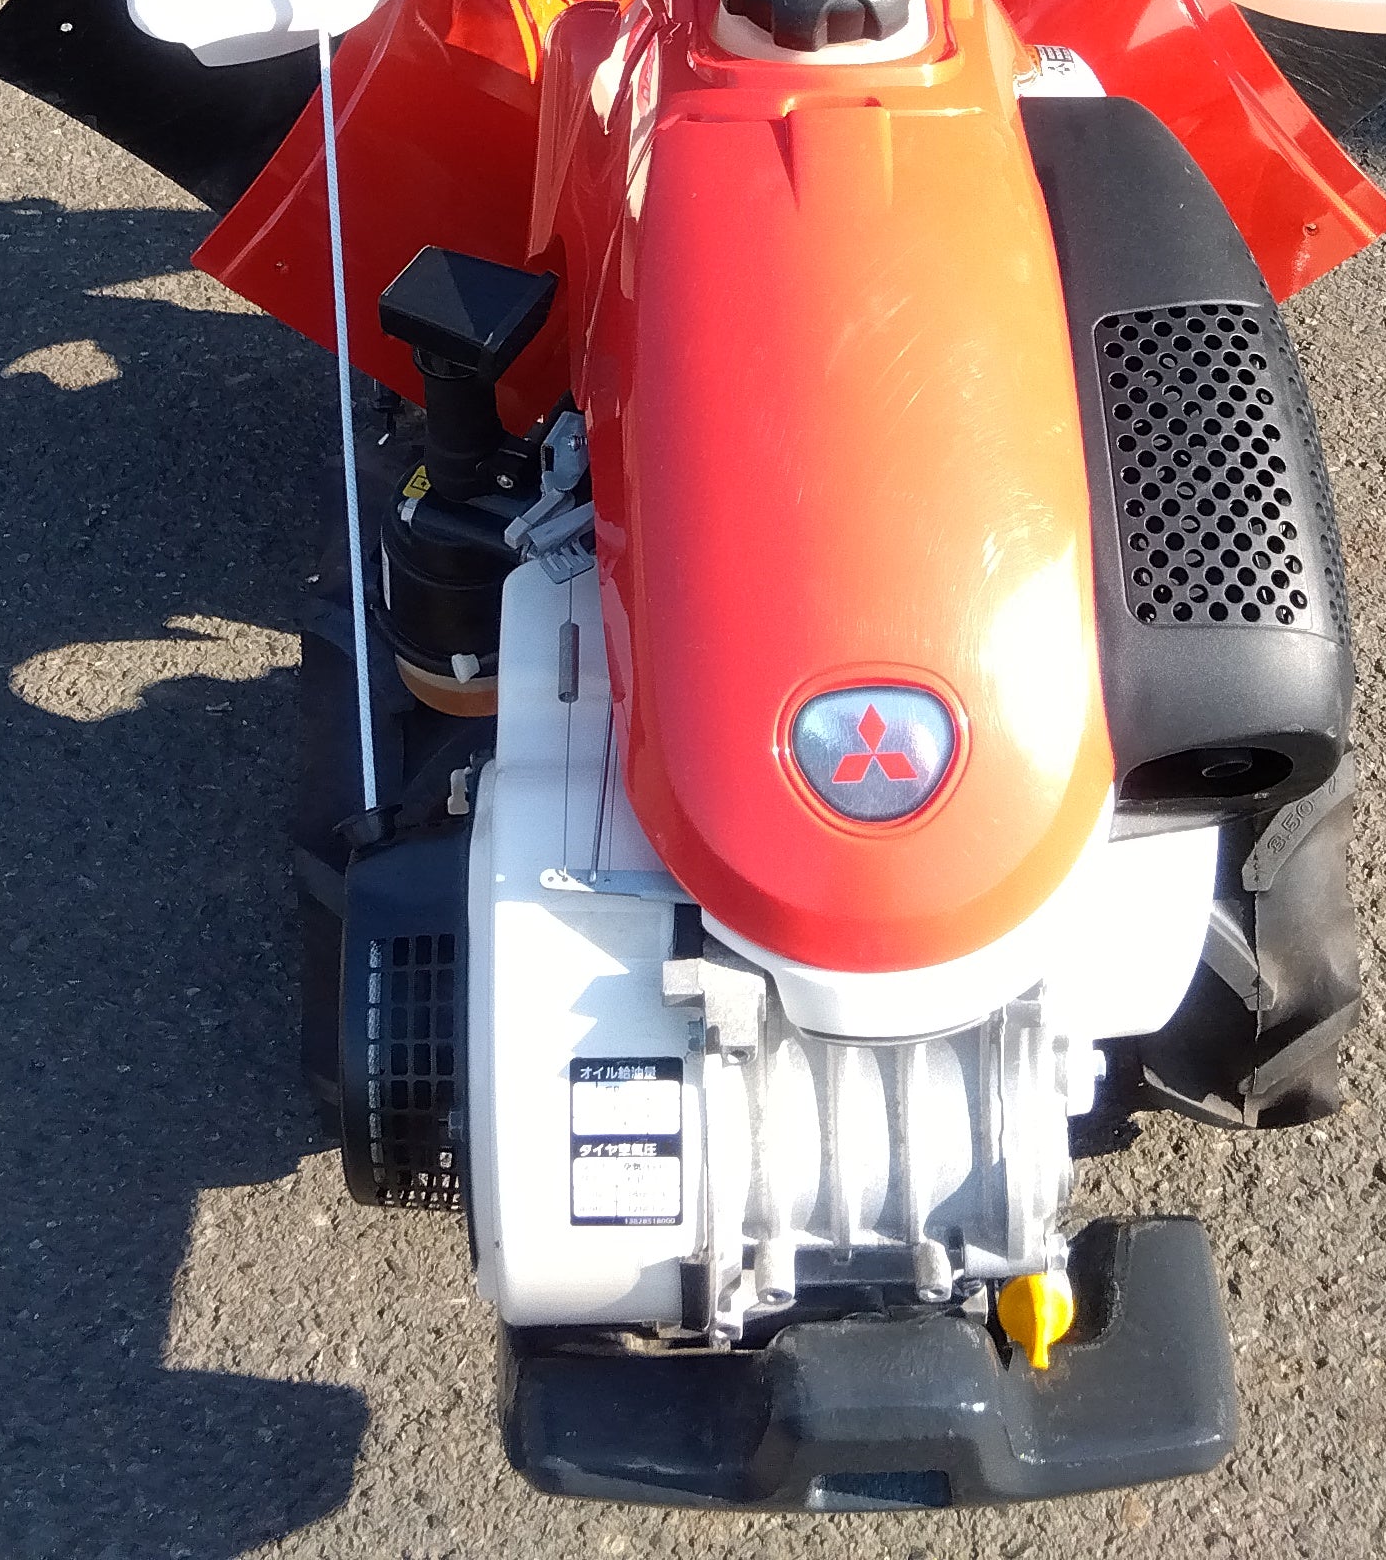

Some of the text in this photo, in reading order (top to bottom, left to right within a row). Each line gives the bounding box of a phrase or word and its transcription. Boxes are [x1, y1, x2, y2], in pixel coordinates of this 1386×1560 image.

[580, 1066, 657, 1080] オイル給油量
[579, 1142, 657, 1157] タイヤ空気圧
